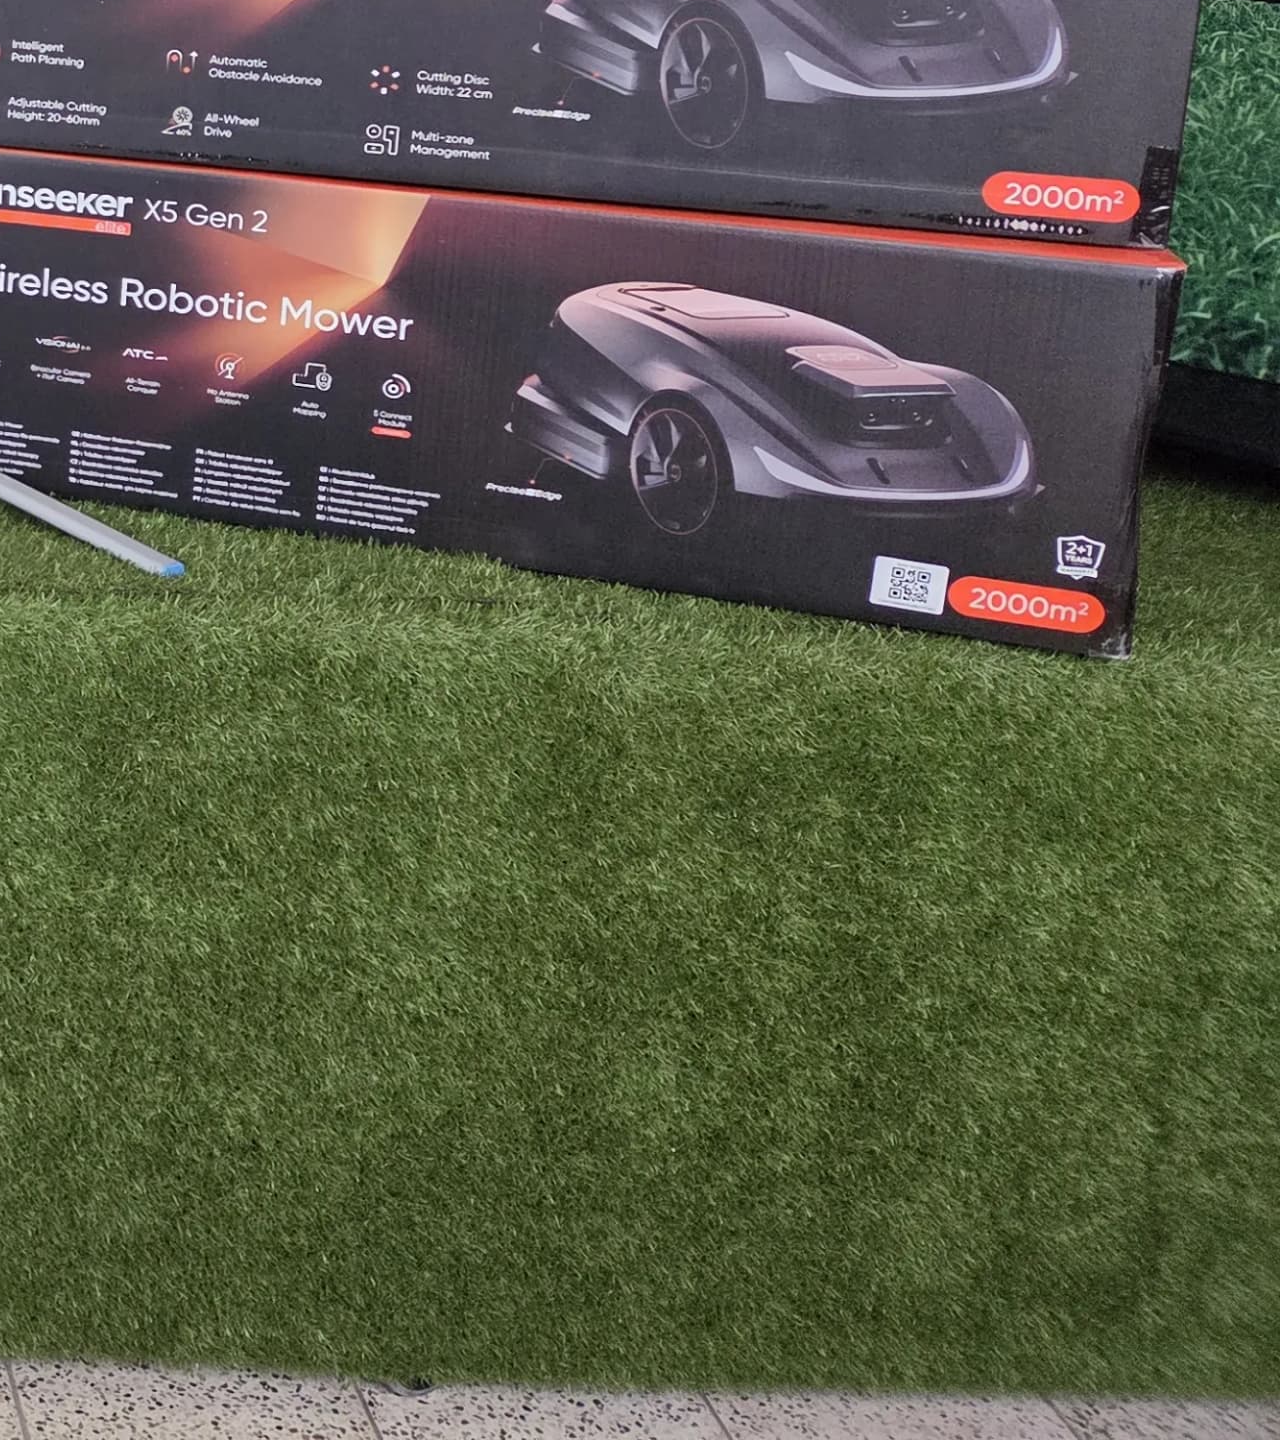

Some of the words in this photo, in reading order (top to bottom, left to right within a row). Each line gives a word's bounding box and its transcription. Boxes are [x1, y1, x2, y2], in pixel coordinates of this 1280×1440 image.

[12, 39, 64, 53] Intelligent
[11, 52, 38, 64] Path
[39, 54, 85, 69] Planning
[209, 55, 268, 68] Automatic
[208, 68, 260, 82] Obstacle
[261, 72, 322, 86] Avoidance
[417, 70, 461, 85] Cutting
[464, 74, 490, 86] Disc
[416, 84, 454, 97] Width:
[456, 87, 472, 98] 22
[473, 90, 493, 100] cm
[8, 96, 64, 111] Adjustable
[67, 101, 107, 116] Cutting
[7, 109, 45, 124] Height:
[47, 113, 100, 126] 20-60mm
[204, 113, 260, 126] All-Wheel
[203, 126, 232, 138] Drive
[411, 130, 475, 145] Multi-zone
[410, 144, 491, 160] Management
[144, 198, 178, 223] X5
[185, 204, 244, 230] Gen
[251, 210, 268, 233] 2
[95, 221, 126, 235] elite
[120, 277, 267, 323] Robotic
[280, 296, 414, 340] Mower
[122, 348, 154, 360] ATC
